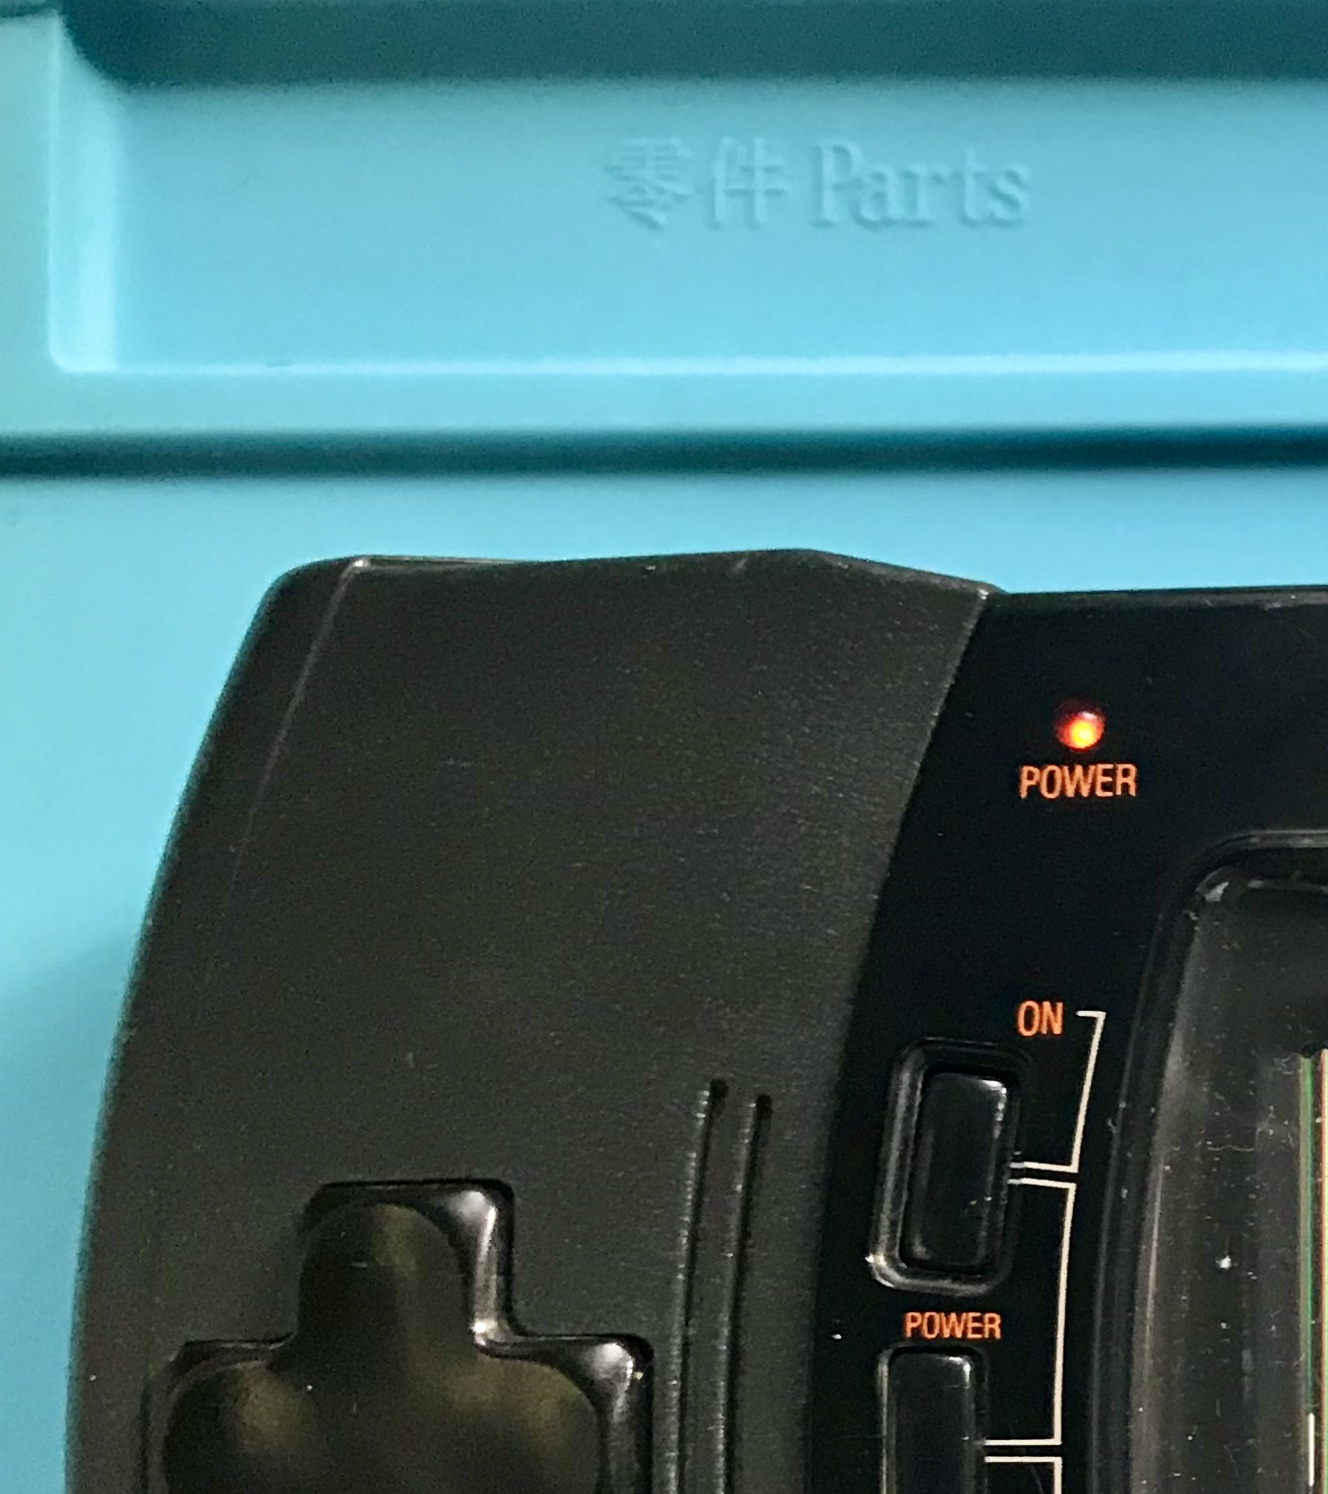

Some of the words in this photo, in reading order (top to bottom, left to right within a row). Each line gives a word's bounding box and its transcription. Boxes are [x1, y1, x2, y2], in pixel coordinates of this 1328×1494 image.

[808, 138, 1030, 229] Parts
[1019, 762, 1138, 800] POWER
[1016, 1000, 1064, 1036] ON
[904, 1312, 1001, 1340] POWER
